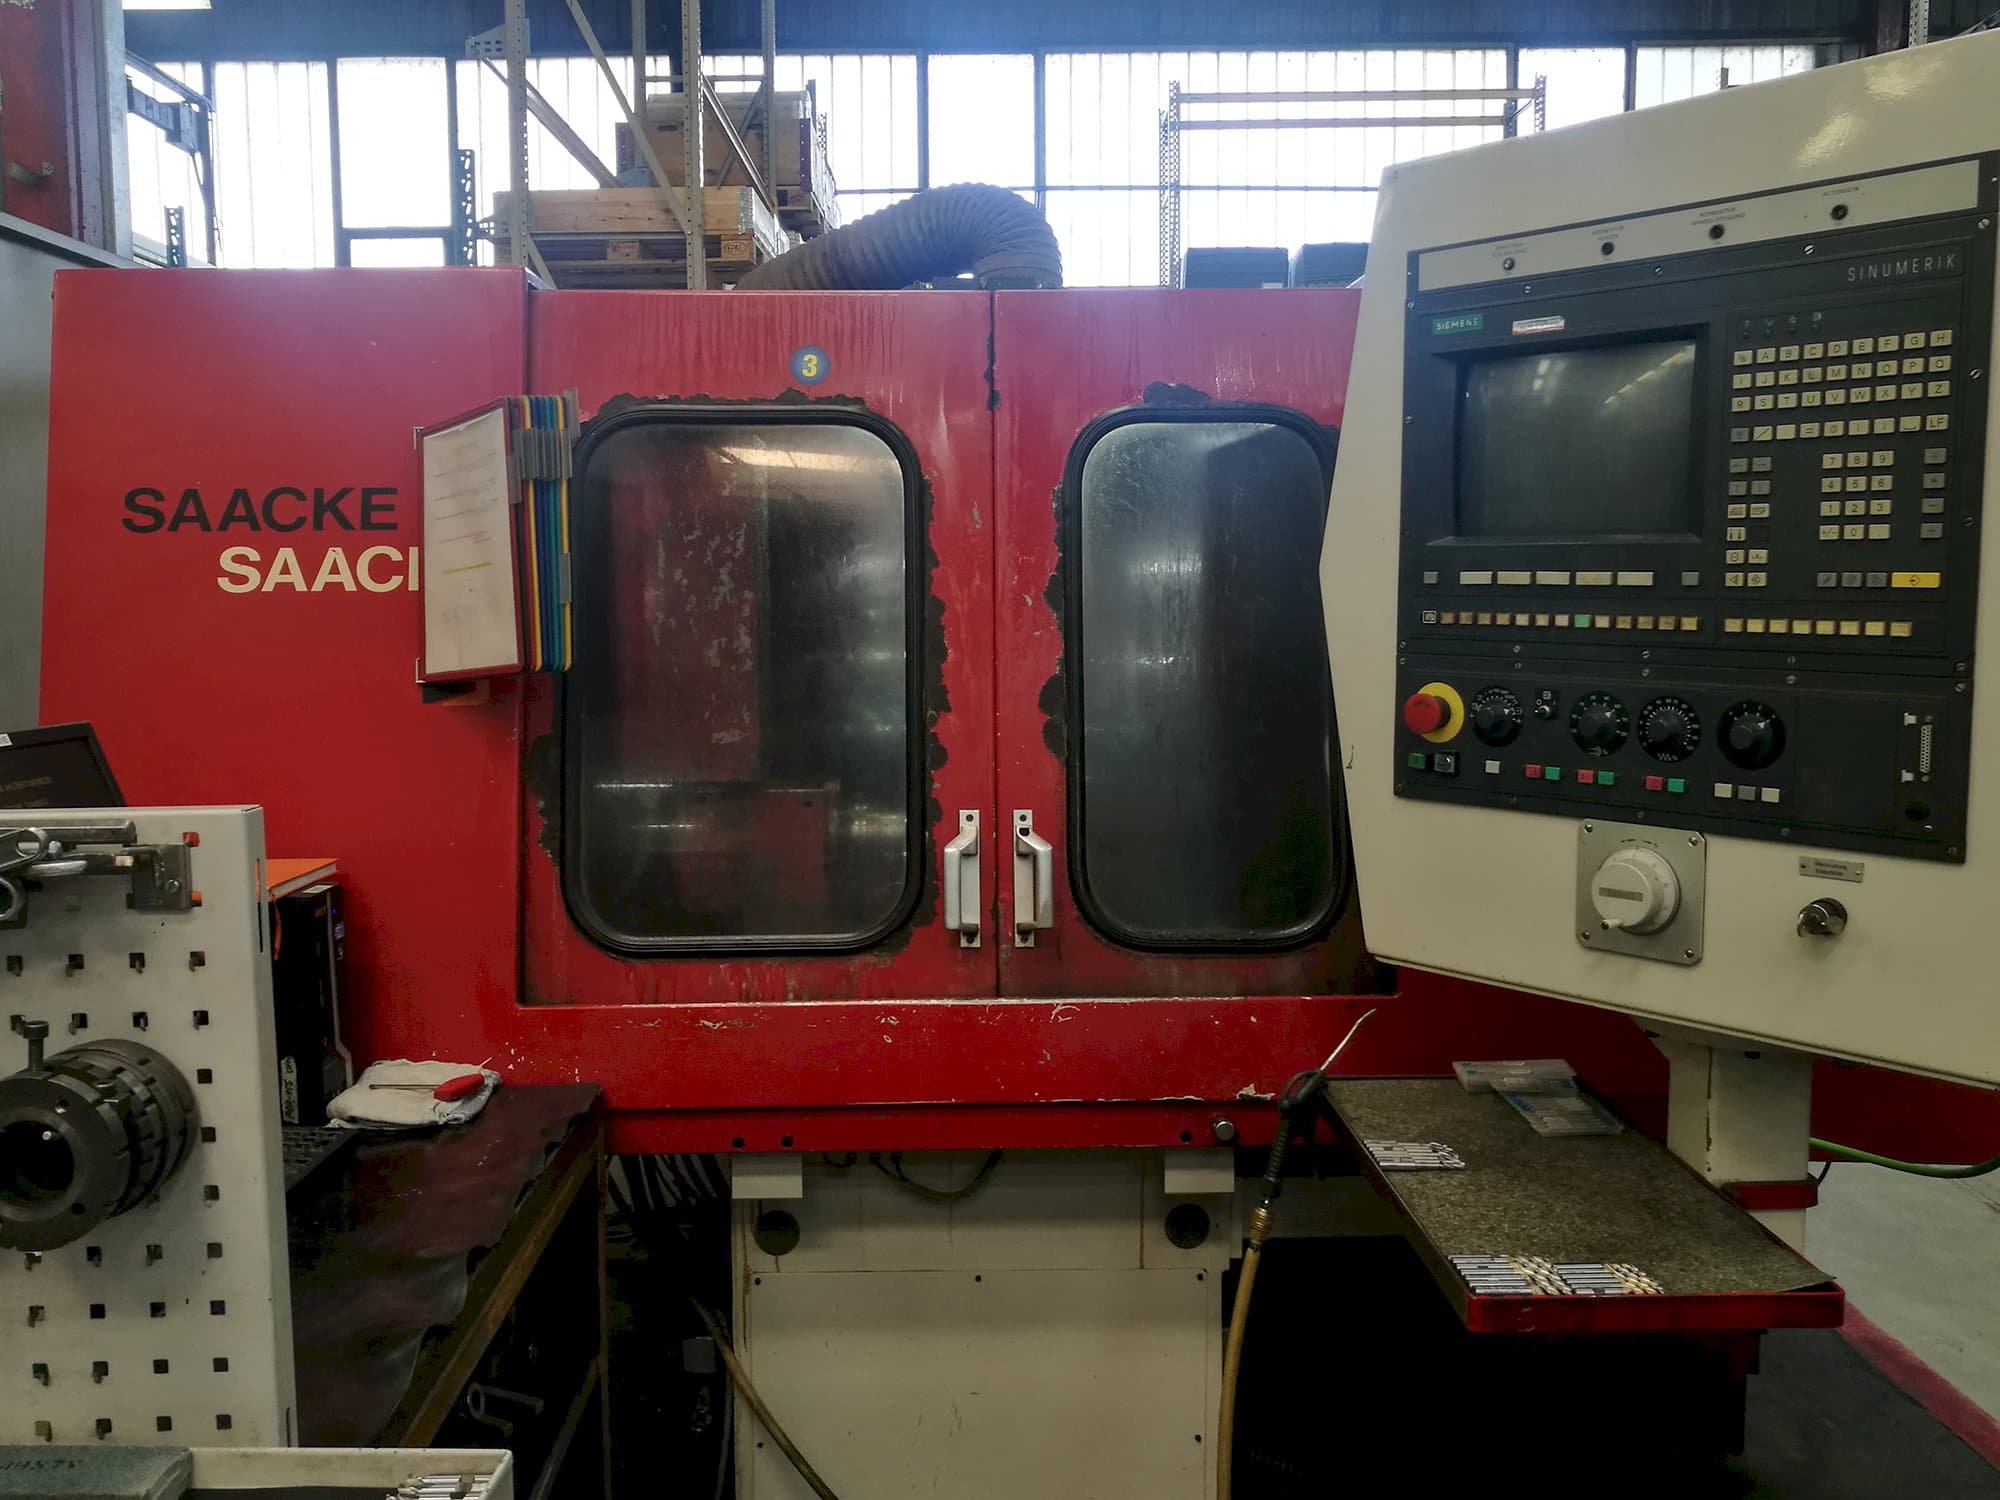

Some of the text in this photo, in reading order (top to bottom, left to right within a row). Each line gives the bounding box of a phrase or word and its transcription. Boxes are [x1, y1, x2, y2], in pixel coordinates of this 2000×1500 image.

[1847, 253, 1956, 282] SINUMERIK
[1435, 317, 1479, 331] SIEMENS
[802, 354, 817, 377] 3
[1930, 417, 1945, 428] LF
[121, 486, 399, 534] SAACKE
[217, 545, 420, 594] SAAC
